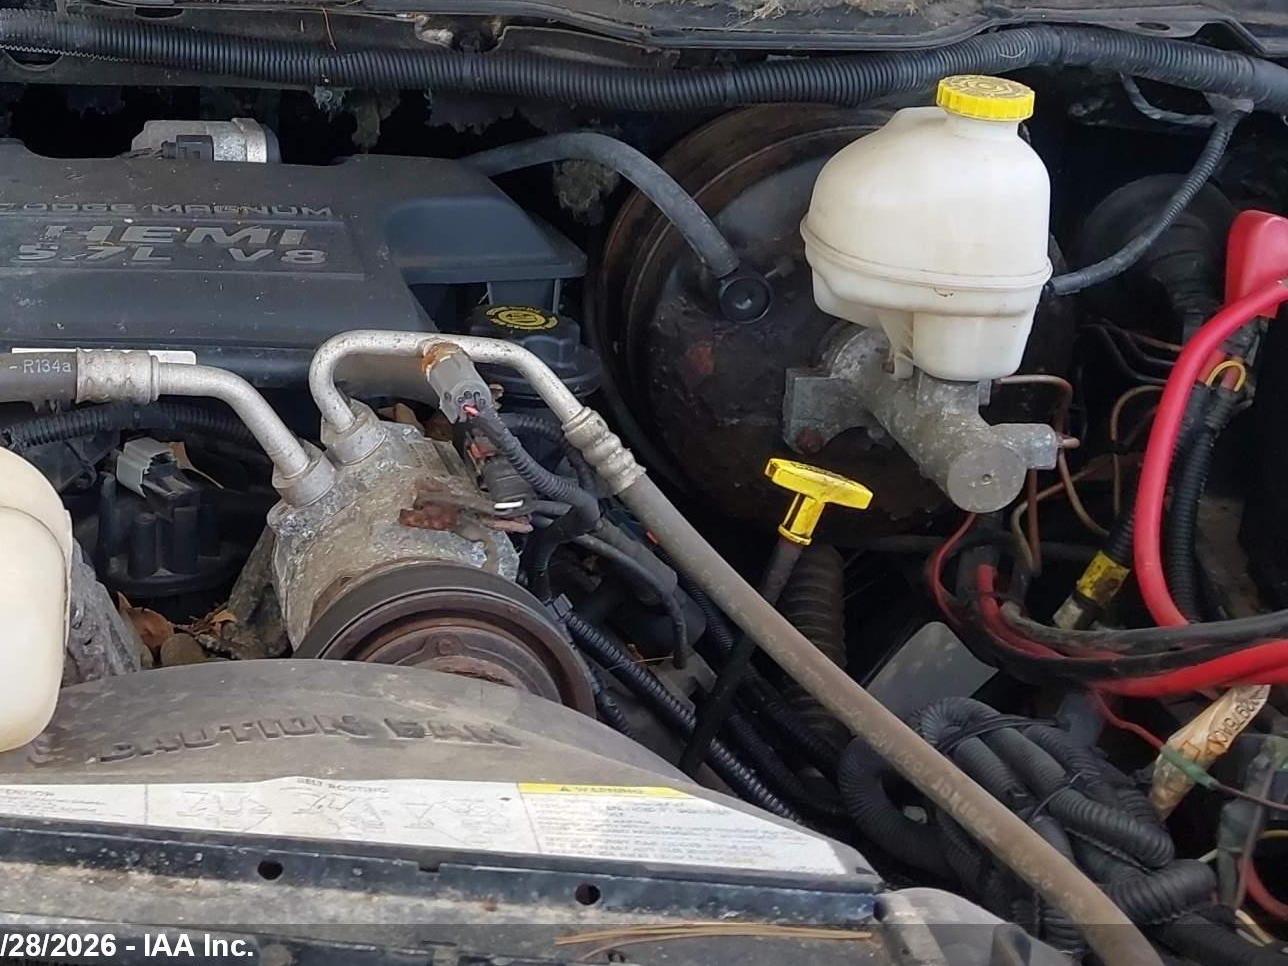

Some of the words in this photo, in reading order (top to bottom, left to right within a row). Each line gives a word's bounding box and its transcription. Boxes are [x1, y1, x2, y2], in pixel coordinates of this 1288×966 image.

[40, 224, 307, 246] HEMI
[14, 244, 172, 264] 5.7L
[229, 247, 328, 265] V8
[23, 359, 72, 374] R134a
[100, 714, 368, 763] CAUTION
